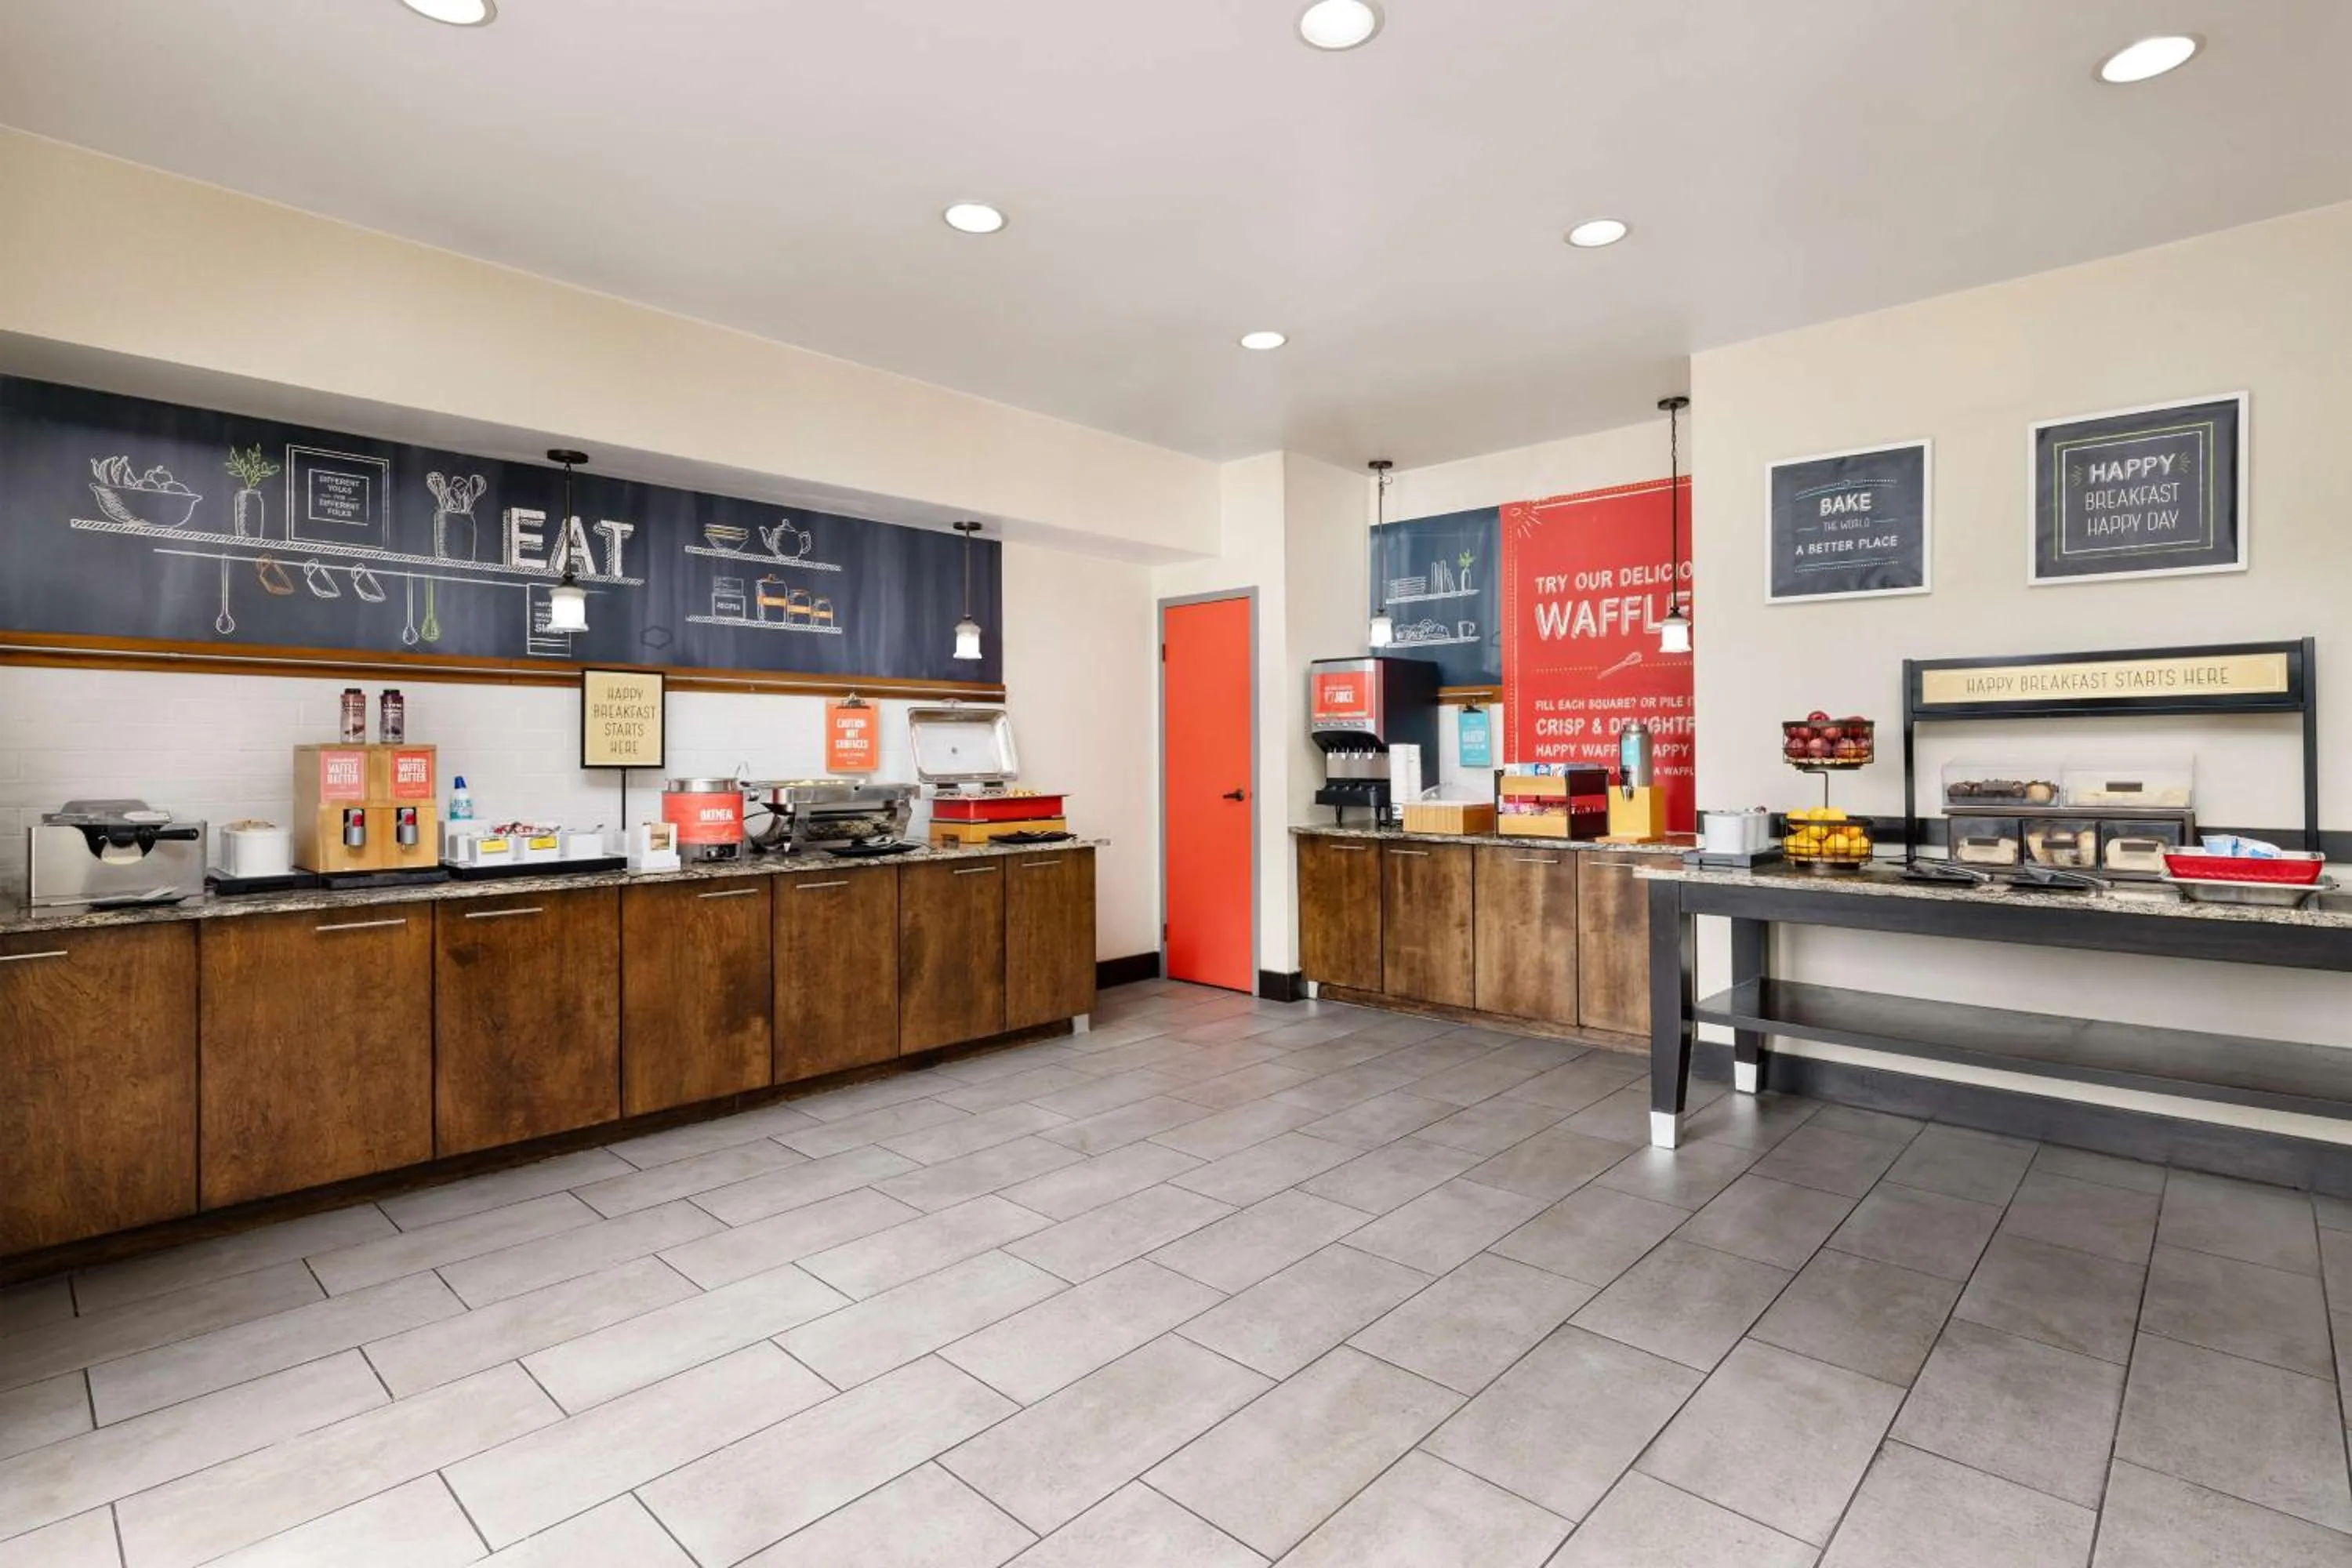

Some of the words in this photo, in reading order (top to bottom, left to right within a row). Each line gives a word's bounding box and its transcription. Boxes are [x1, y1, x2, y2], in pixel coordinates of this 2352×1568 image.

[2089, 453, 2176, 484] HAPPY
[1820, 492, 1872, 516] BAKE
[2085, 482, 2180, 510] BREAKFAST
[1824, 521, 1838, 532] THE
[1841, 517, 1871, 530] WORLD
[2088, 514, 2142, 536] HAPPY
[2147, 509, 2179, 531] DAY
[503, 507, 634, 577] EAT
[1795, 546, 1804, 555] A
[1808, 540, 1853, 554] BETTER
[1859, 535, 1898, 550] PLACE
[1534, 574, 1568, 594] TRY
[1575, 570, 1613, 591] OUR
[1967, 677, 2013, 694] HAPPY
[2020, 672, 2108, 691] BREAKFAST
[2114, 669, 2177, 688] STARTS
[2183, 667, 2230, 684] HERE
[607, 687, 644, 700] HAPPY
[1536, 702, 1555, 711] FILL
[1558, 699, 1584, 710] EACH
[1588, 697, 1636, 710] SQUARE?
[1640, 696, 1657, 708] OR
[1660, 695, 1685, 706] PILE
[593, 703, 655, 719] BREAKFAST
[604, 722, 644, 737] STARTS
[1536, 718, 1585, 735] CRISP
[1592, 717, 1602, 735] &
[610, 740, 638, 754] HERE
[1536, 743, 1579, 757] HAPPY
[1581, 743, 1620, 757] WAFF
[1652, 744, 1689, 757] APPY
